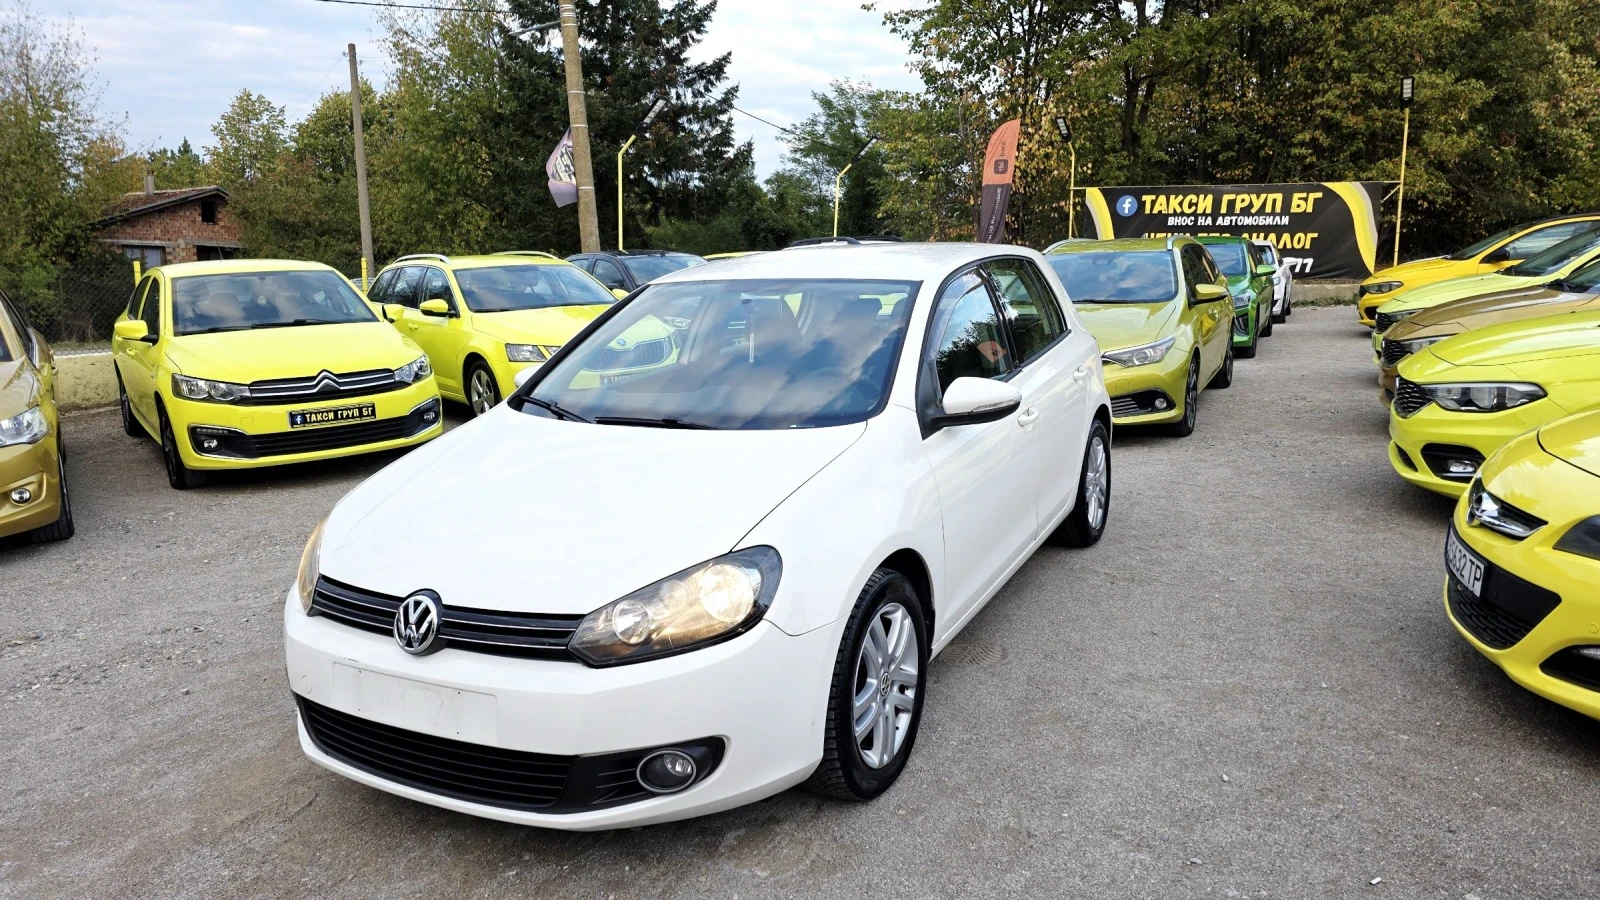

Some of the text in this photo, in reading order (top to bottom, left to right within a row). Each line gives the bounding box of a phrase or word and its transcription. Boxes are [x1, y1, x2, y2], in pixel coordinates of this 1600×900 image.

[1141, 193, 1214, 214] ТАКСИ
[1220, 192, 1283, 214] ГРУП
[1290, 192, 1323, 213] БГ
[1167, 215, 1290, 226] ВНОС НА АВТОМОБИЛИ
[305, 411, 335, 423] ТАКСИ
[338, 408, 359, 419] ГРУП
[362, 407, 373, 416] БГ
